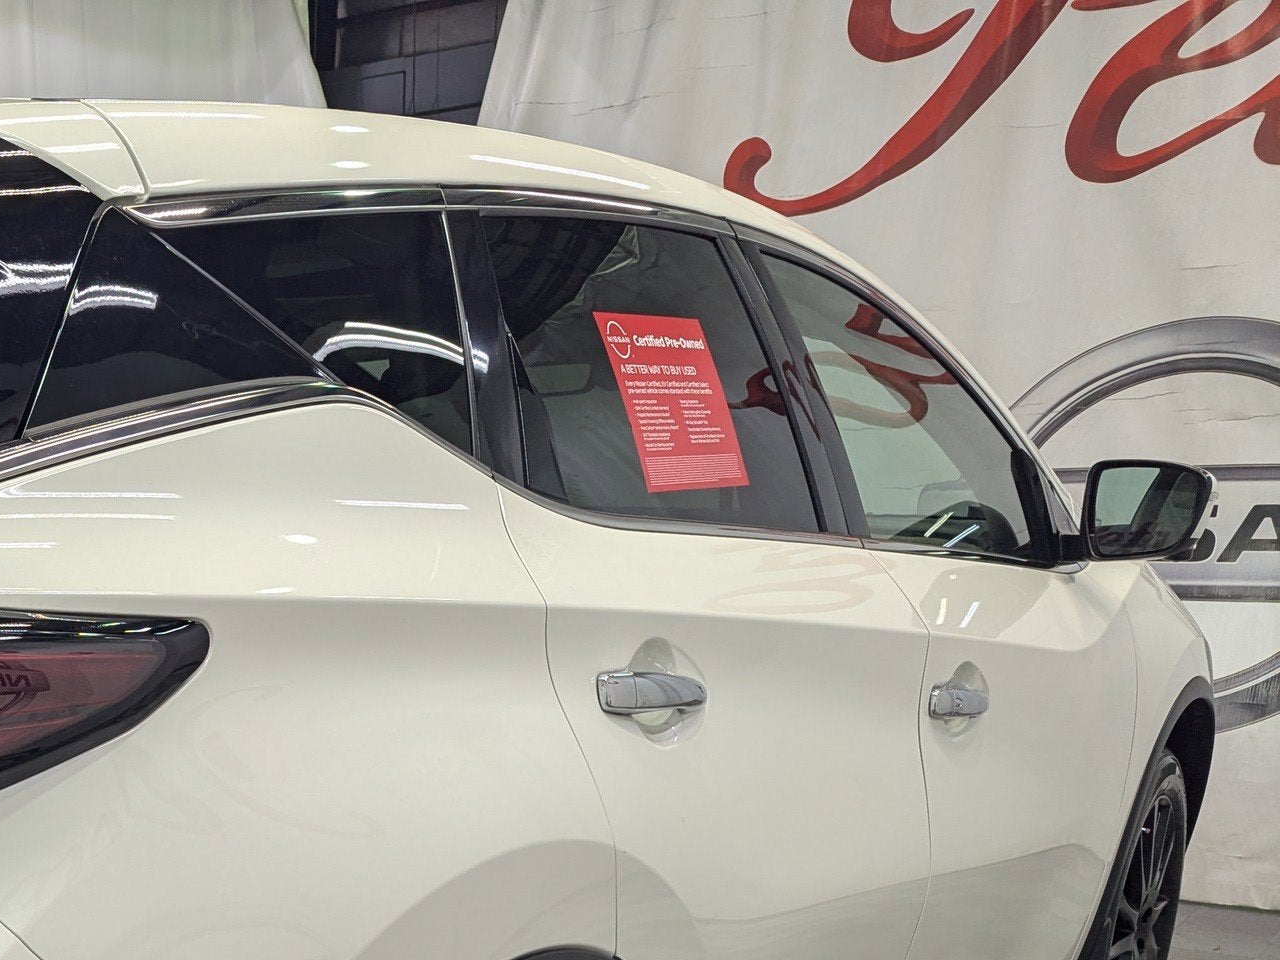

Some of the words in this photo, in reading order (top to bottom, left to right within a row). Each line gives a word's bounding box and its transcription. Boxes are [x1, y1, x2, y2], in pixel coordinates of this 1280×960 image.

[606, 335, 631, 344] NISSAN
[632, 334, 665, 347] Certified
[664, 335, 705, 350] Pre-Owned
[625, 364, 650, 375] BETTER
[648, 364, 661, 375] WAY
[660, 364, 670, 375] TO
[670, 365, 682, 376] BUY
[680, 365, 697, 376] USED
